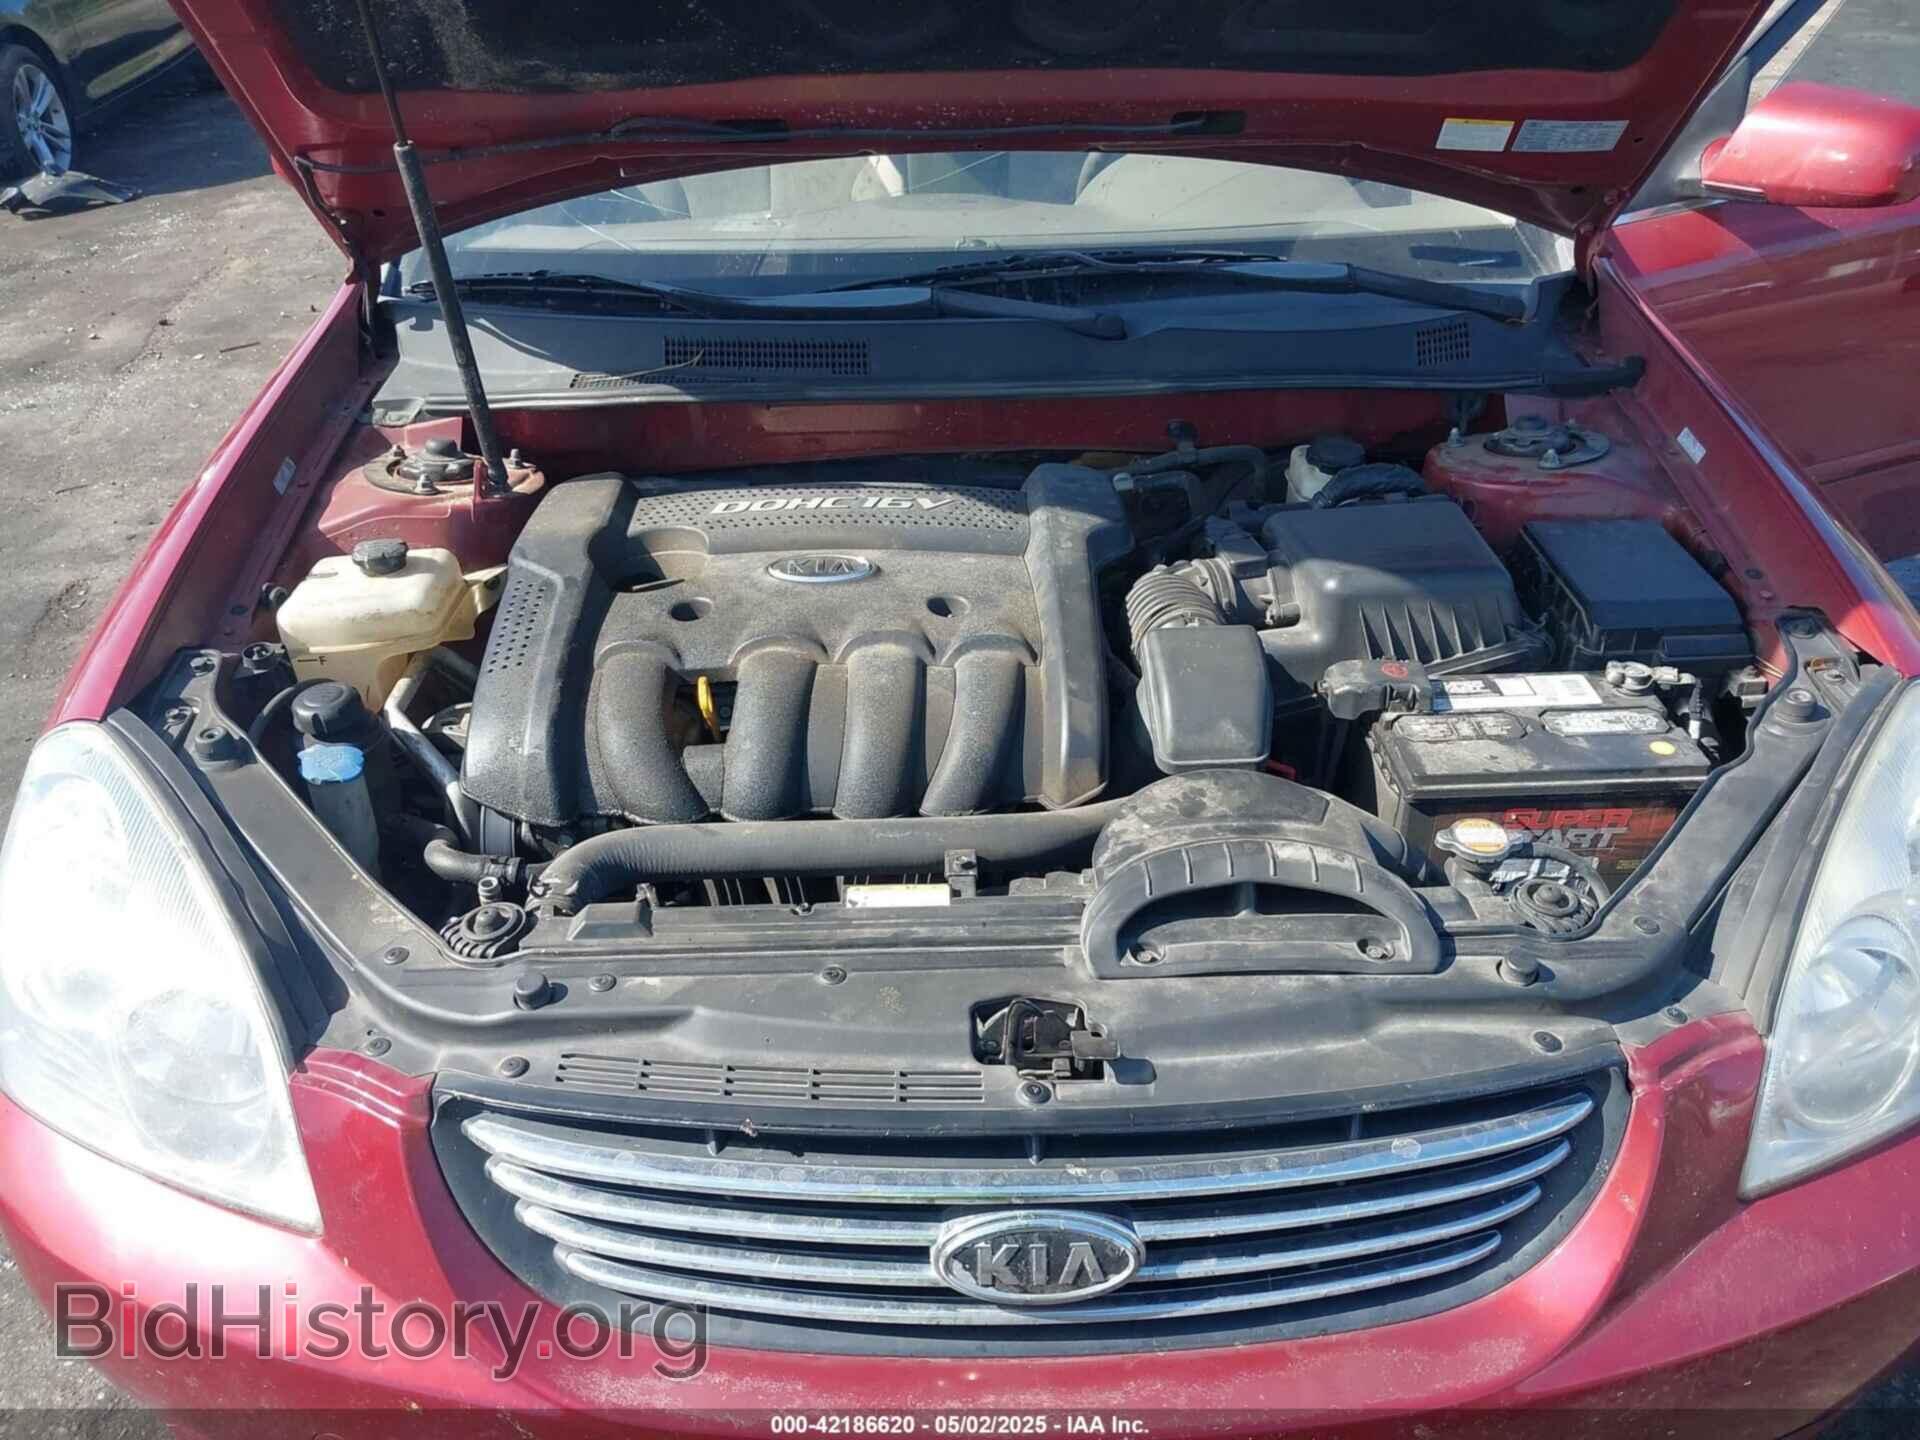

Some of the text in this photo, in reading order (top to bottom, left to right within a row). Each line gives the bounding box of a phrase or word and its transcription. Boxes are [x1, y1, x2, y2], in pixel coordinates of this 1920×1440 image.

[711, 496, 953, 514] DOHC 16V
[786, 558, 850, 576] KIA
[1504, 808, 1633, 830] SUPER
[974, 1241, 1106, 1287] KIA
